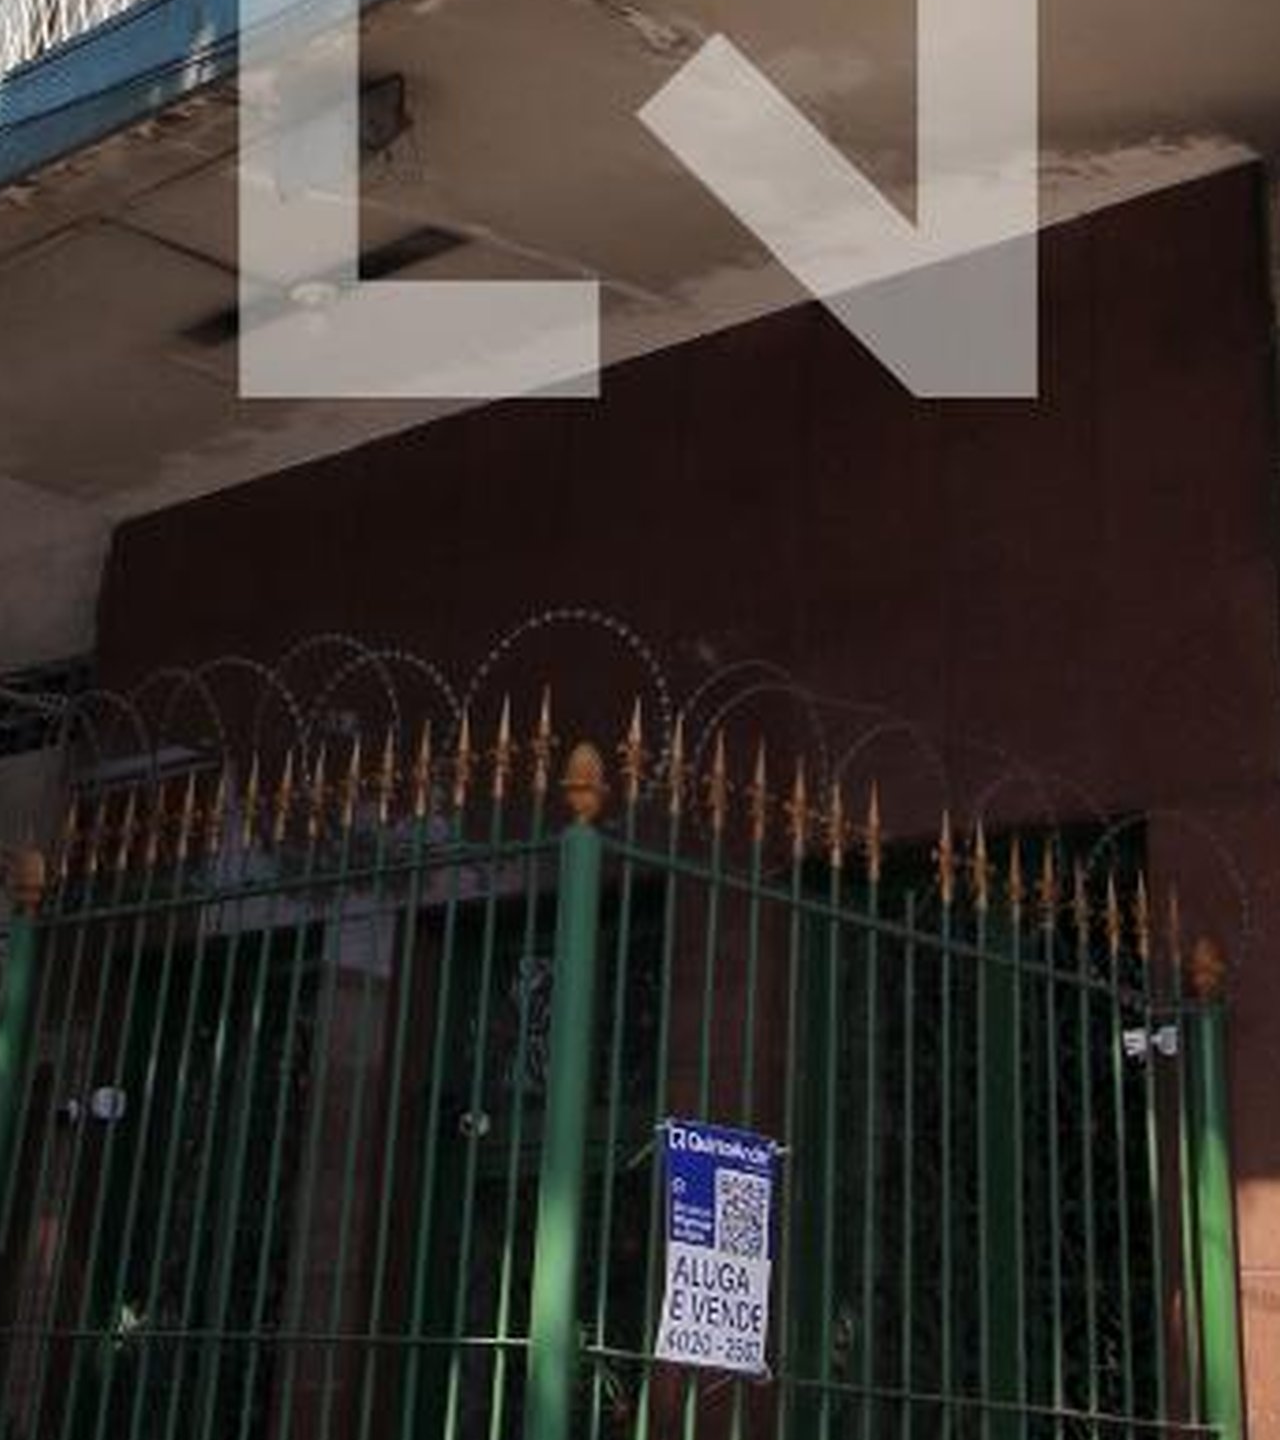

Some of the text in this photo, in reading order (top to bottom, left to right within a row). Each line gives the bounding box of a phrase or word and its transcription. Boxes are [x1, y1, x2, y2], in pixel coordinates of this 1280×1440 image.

[672, 1255, 750, 1296] ALUGA
[669, 1289, 762, 1334] E VENDE
